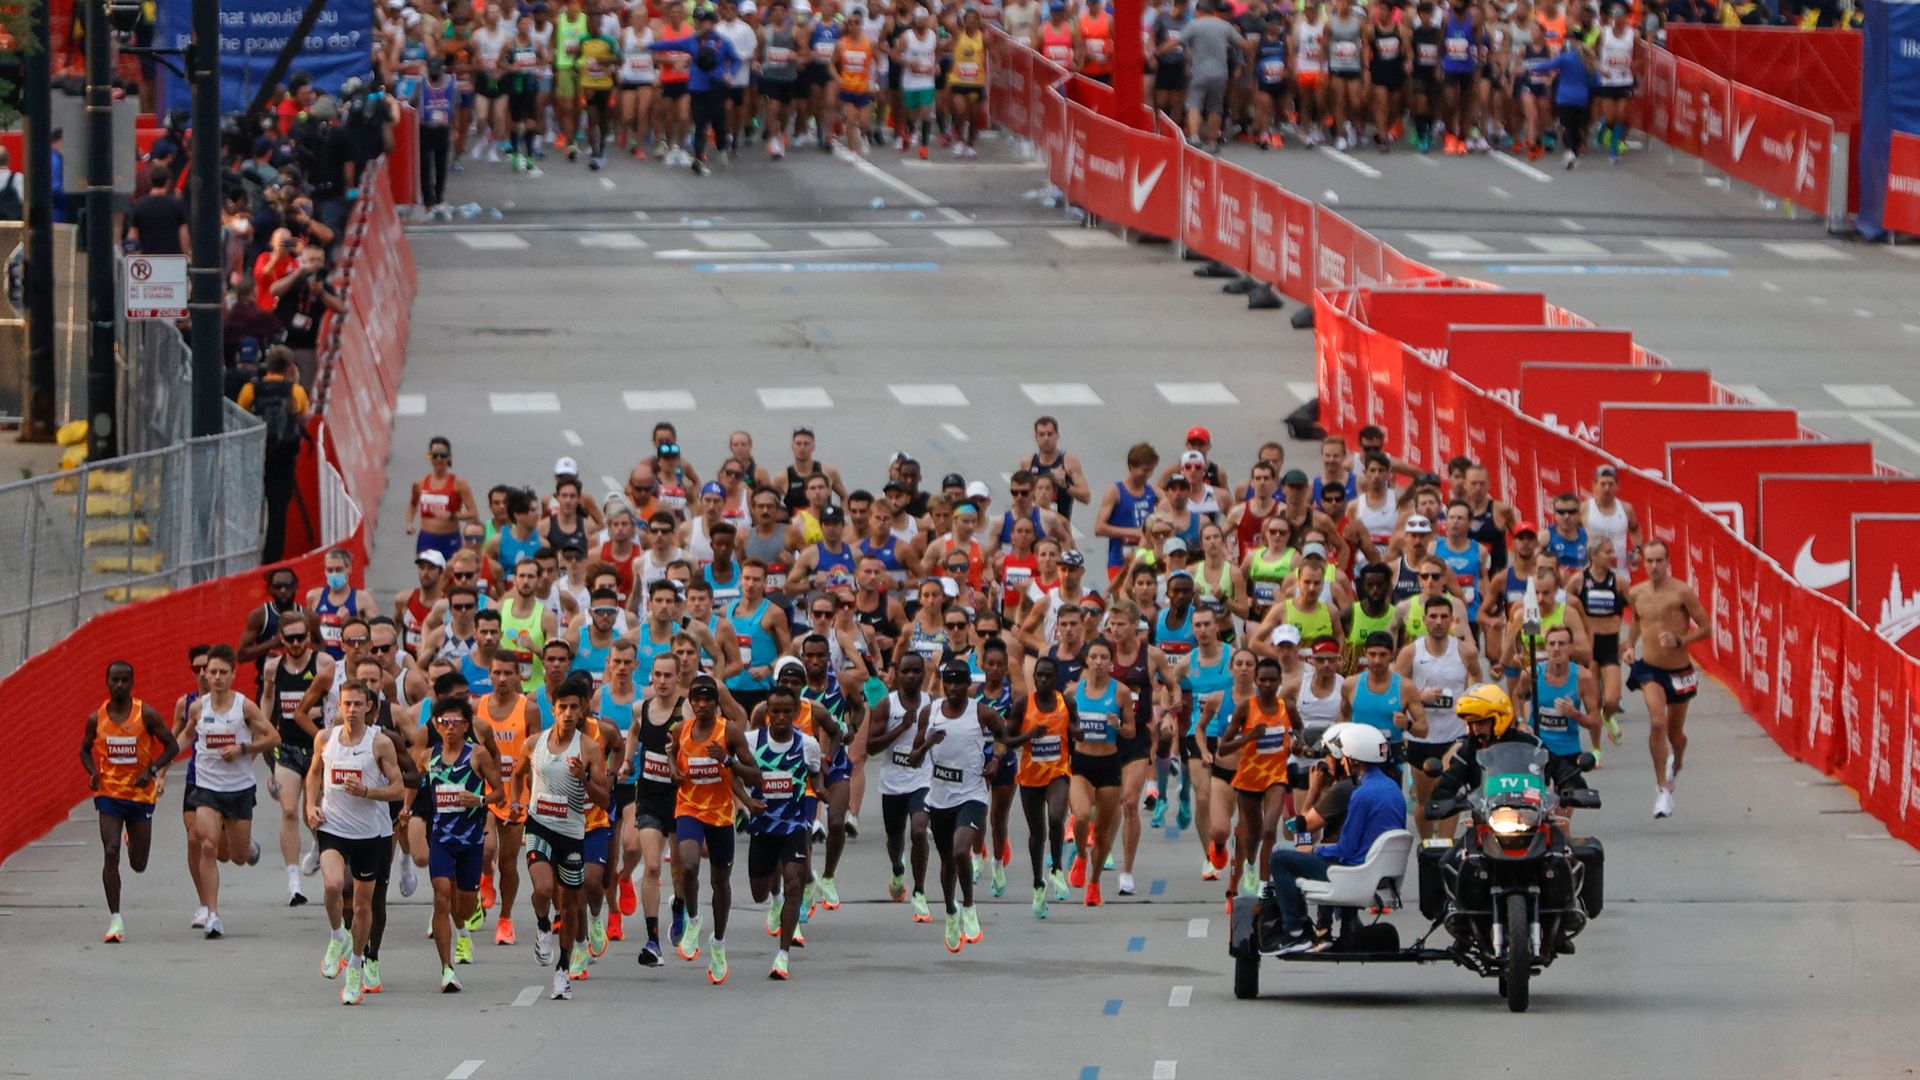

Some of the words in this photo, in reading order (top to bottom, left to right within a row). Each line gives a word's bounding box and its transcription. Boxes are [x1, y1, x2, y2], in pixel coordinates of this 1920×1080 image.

[327, 30, 361, 49] do?
[1080, 721, 1105, 731] BATES
[108, 745, 136, 755] TAMRU
[895, 754, 910, 765] PAC
[690, 766, 718, 775] KIPYEGO
[935, 767, 954, 779] PACE
[956, 771, 960, 780] 1
[765, 781, 790, 790] ABDO
[1499, 777, 1519, 788] TV
[1523, 778, 1529, 788] 1
